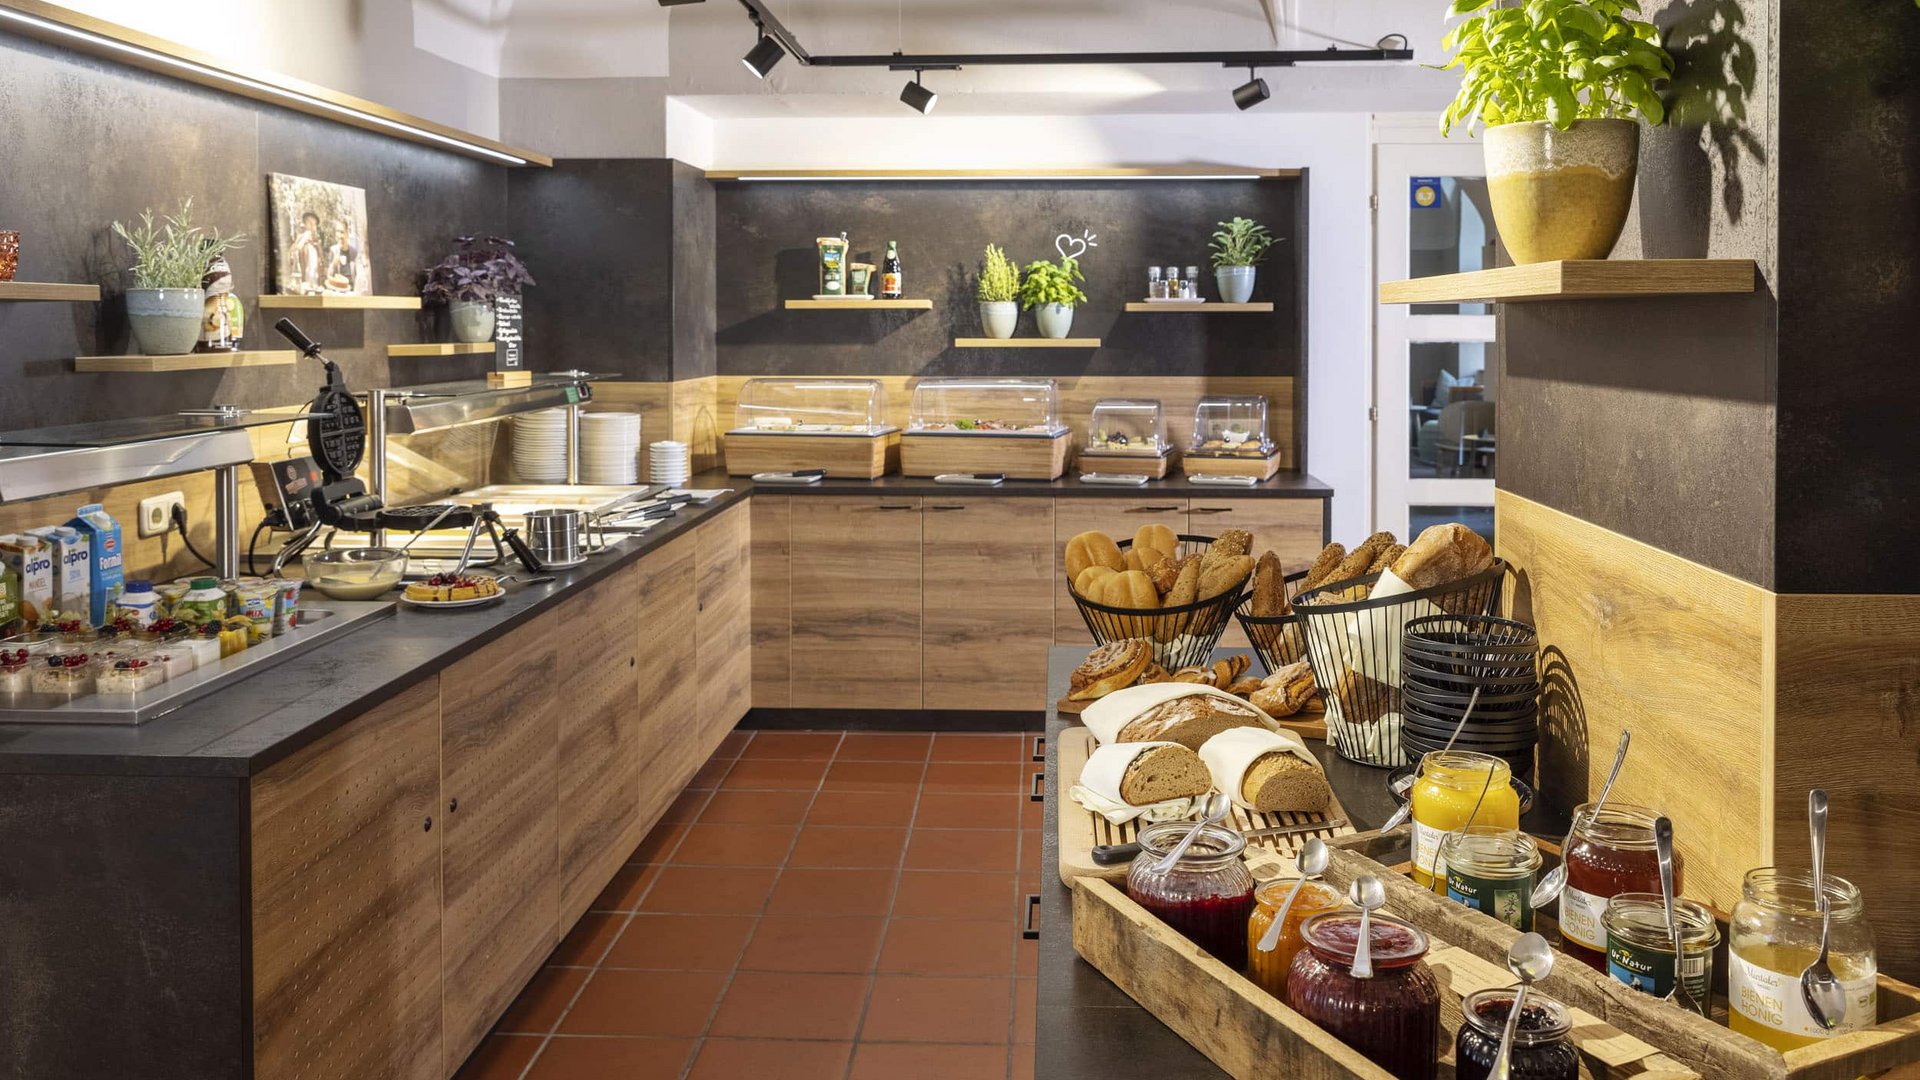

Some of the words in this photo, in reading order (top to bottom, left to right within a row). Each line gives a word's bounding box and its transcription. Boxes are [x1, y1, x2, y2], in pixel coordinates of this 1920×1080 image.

[25, 558, 51, 575] alpro
[63, 550, 88, 566] alpro
[1455, 881, 1478, 894] Natur
[1565, 906, 1595, 928] BIENEN
[1565, 917, 1596, 940] HONIG
[1621, 956, 1653, 972] Natur
[1741, 986, 1783, 1011] BIENEN
[1741, 999, 1783, 1025] HONIG
